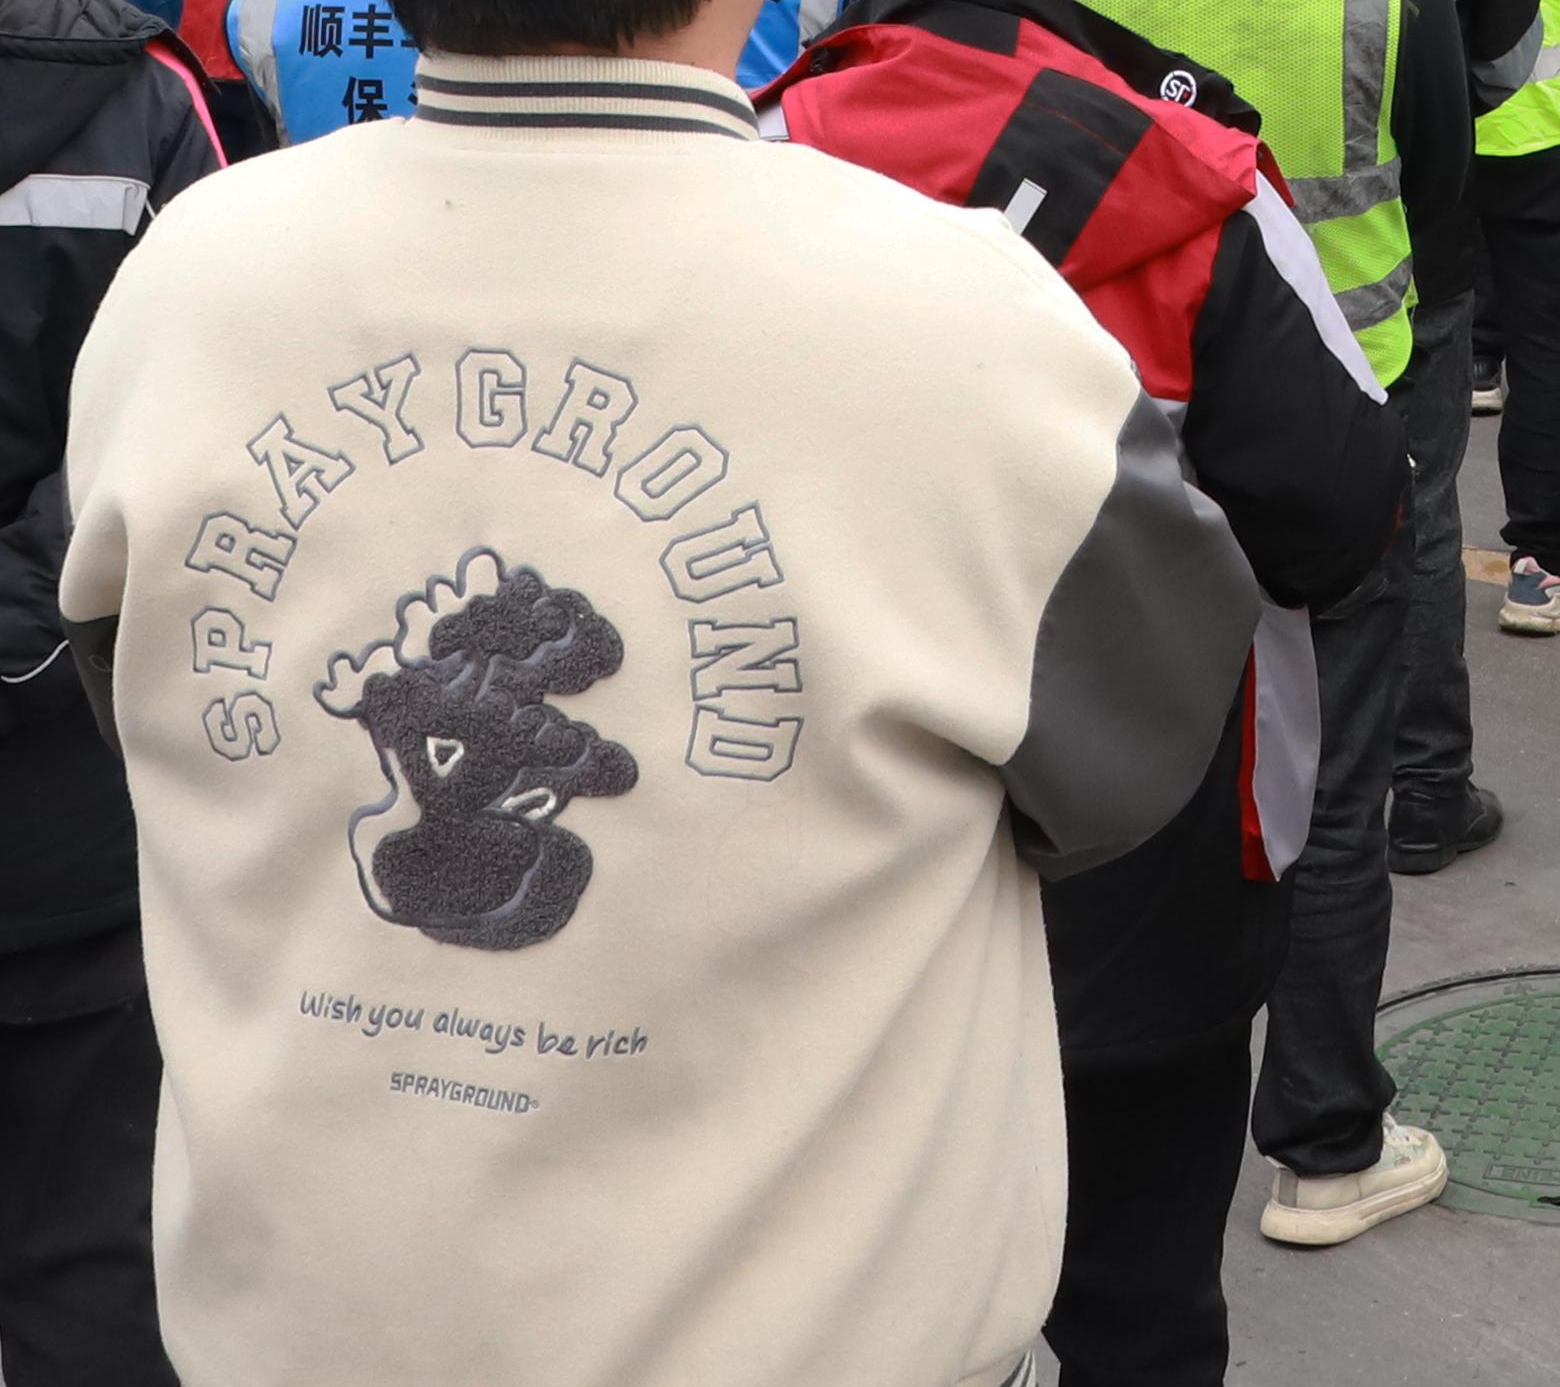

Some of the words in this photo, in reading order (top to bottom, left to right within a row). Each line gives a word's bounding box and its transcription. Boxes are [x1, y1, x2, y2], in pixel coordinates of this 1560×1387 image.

[183, 346, 805, 785] SPRAYGROUND
[298, 989, 363, 1024] Wish
[361, 1003, 425, 1038] you
[432, 1006, 528, 1055] always
[536, 1020, 578, 1057] be
[584, 1025, 649, 1059] rich
